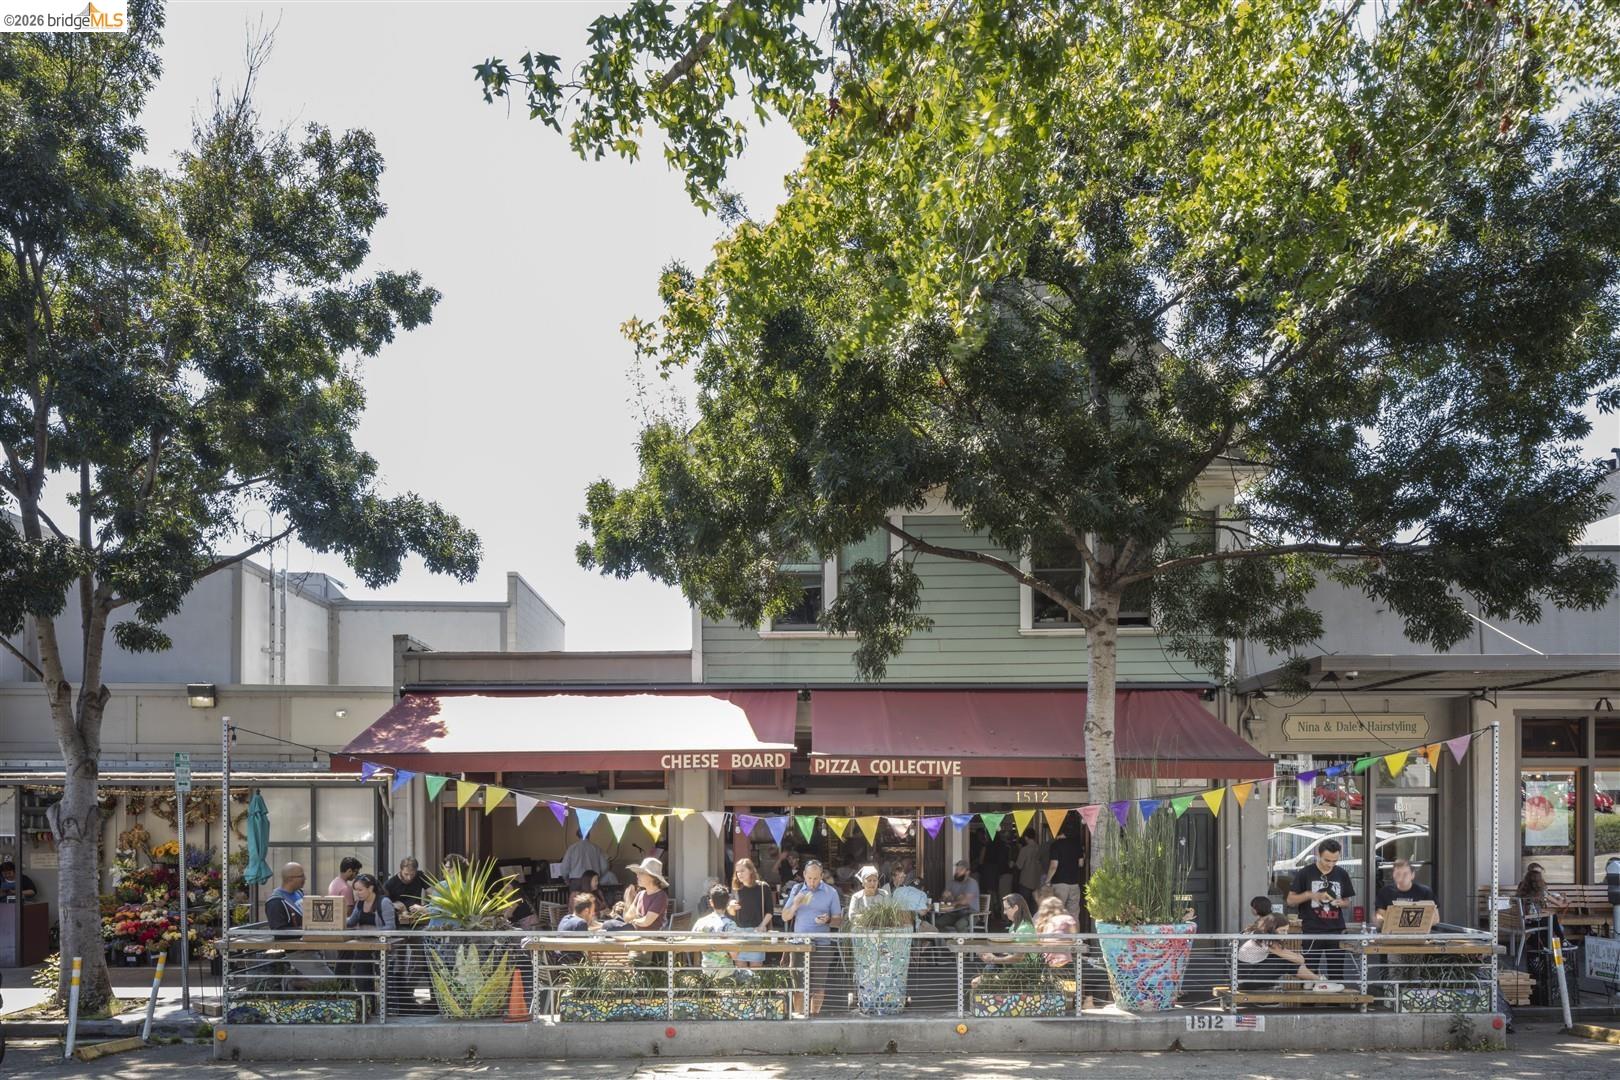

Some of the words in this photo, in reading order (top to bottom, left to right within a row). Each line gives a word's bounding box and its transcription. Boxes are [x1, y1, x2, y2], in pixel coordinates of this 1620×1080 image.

[1298, 721, 1320, 732] Nina
[1323, 721, 1332, 732] &
[1336, 721, 1363, 732] Dale's
[1367, 721, 1417, 734] Hairstyling
[661, 754, 719, 769] CHEESE
[731, 753, 785, 768] BOARD
[815, 759, 860, 774] PIZZA
[870, 759, 962, 775] COLLECTIVE
[1016, 790, 1049, 803] 1512
[1191, 1015, 1224, 1029] 1512
